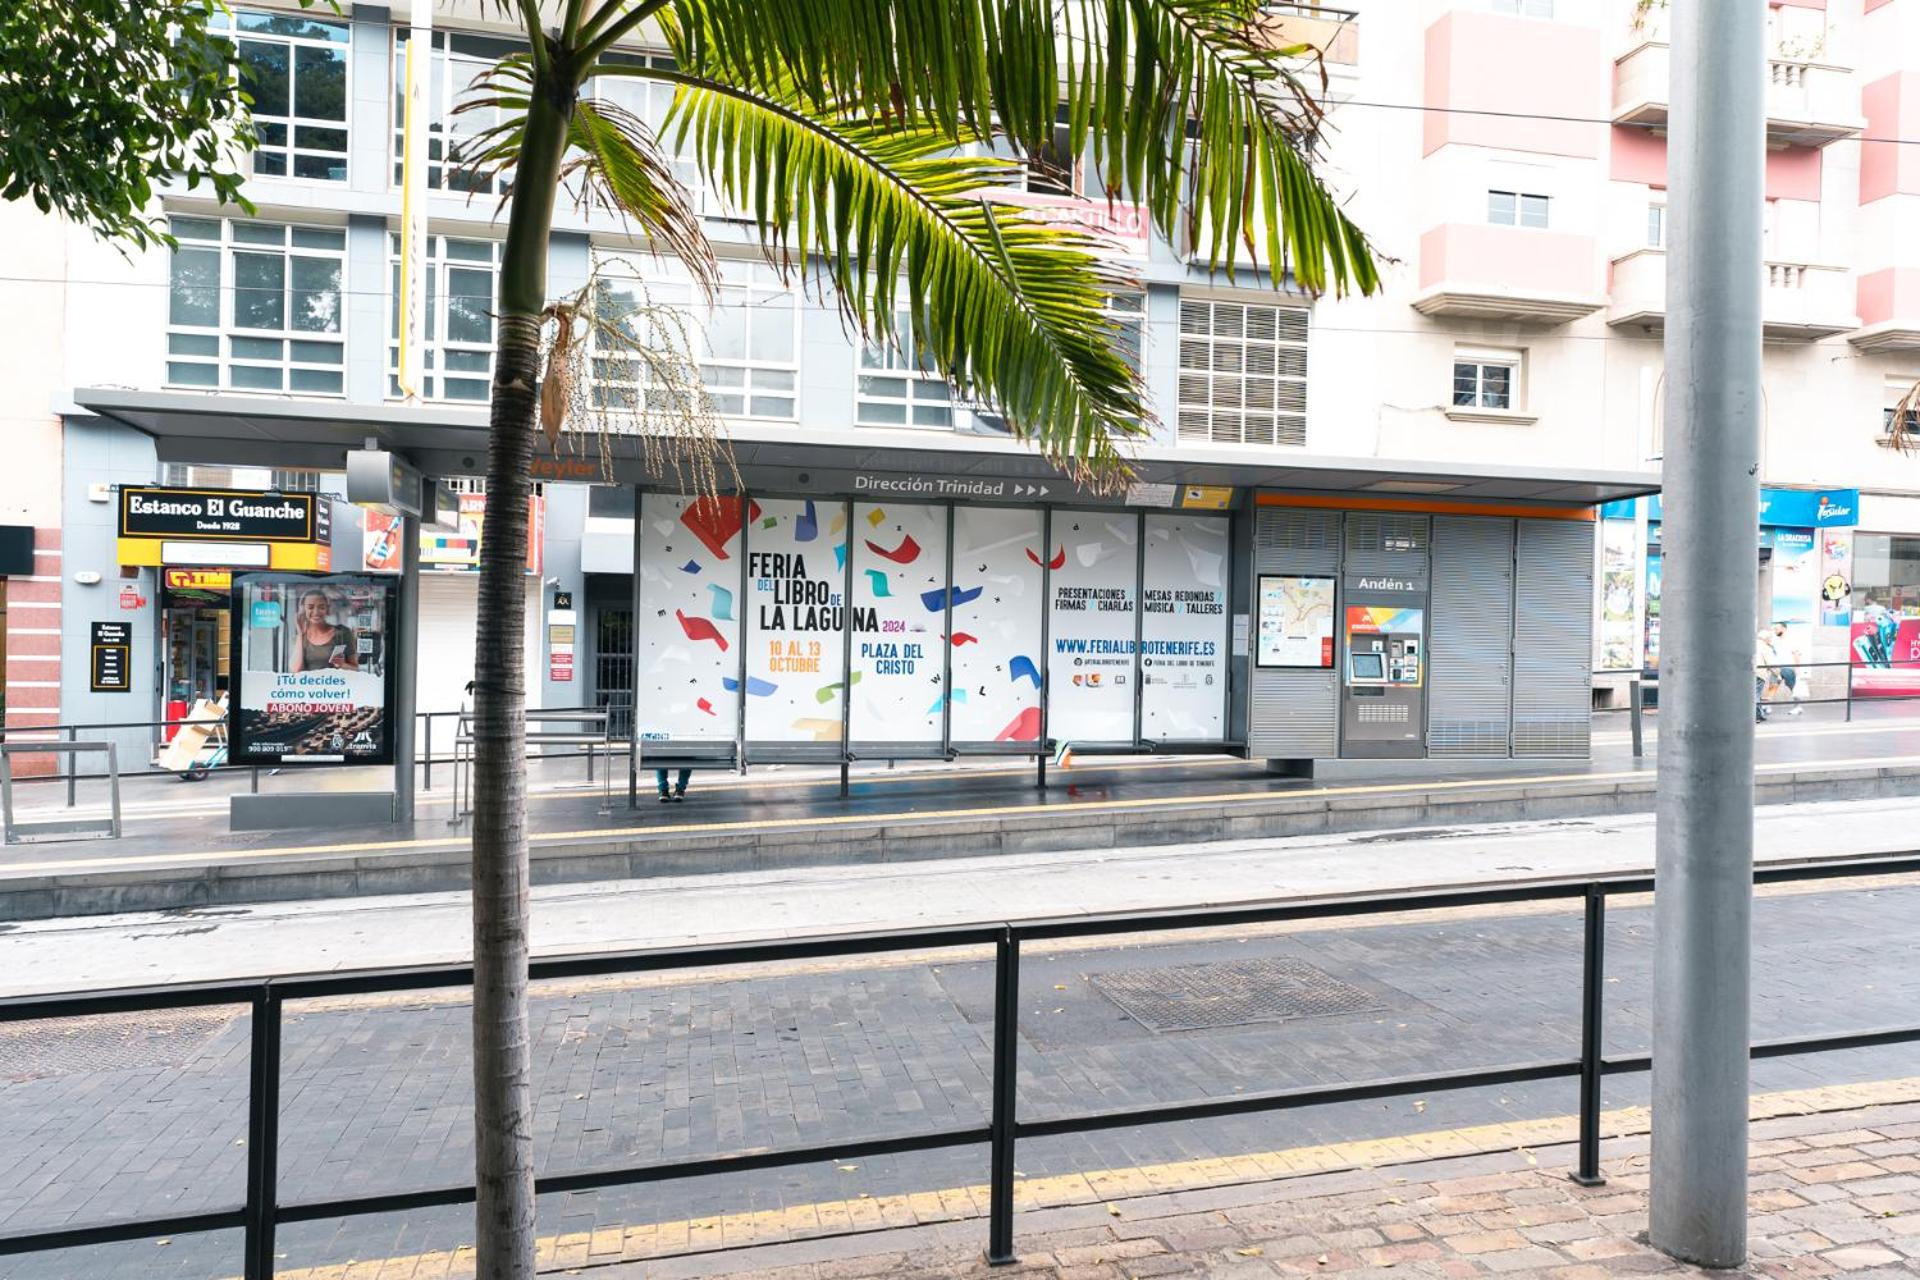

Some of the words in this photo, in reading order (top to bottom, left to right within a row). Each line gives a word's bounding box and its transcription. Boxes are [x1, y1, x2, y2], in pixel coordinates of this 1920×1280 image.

[855, 476, 933, 493] Dirección
[937, 479, 1004, 496] Trinidad
[130, 496, 202, 515] Estanco
[207, 499, 224, 517] El
[229, 501, 305, 519] Guanche
[196, 520, 221, 531] Desde
[749, 553, 807, 579] FERIA
[1358, 577, 1404, 590] Andén
[1405, 582, 1415, 591] 1
[757, 579, 774, 591] DEL
[774, 579, 829, 605] LIBRO
[830, 593, 842, 606] DE
[1058, 587, 1126, 600] PRESENTACIONES
[1144, 590, 1172, 602] MESAS
[1175, 591, 1215, 602] REDONDAS
[1055, 599, 1087, 611] FIRMAS
[1097, 600, 1134, 612] CHARLAS
[1186, 603, 1224, 615] TALLERES
[760, 605, 785, 631] LA
[793, 606, 879, 632] LAGUNA
[882, 620, 906, 632] 2024
[769, 641, 782, 656] 10
[788, 641, 801, 656] AL
[809, 641, 821, 656] 13
[861, 643, 898, 658] PLAZA
[904, 644, 924, 659] DEL
[1055, 639, 1216, 656] WWW.FERIALIBROTENERIFE.ES
[769, 658, 820, 673] OCTUBRE
[876, 660, 915, 675] CRISTO
[277, 675, 296, 687] ¡Tú
[299, 675, 346, 686] decides
[270, 687, 305, 699] cómo
[308, 688, 351, 700] volver!
[270, 704, 312, 713] ABONO
[314, 704, 350, 713] JOVEN
